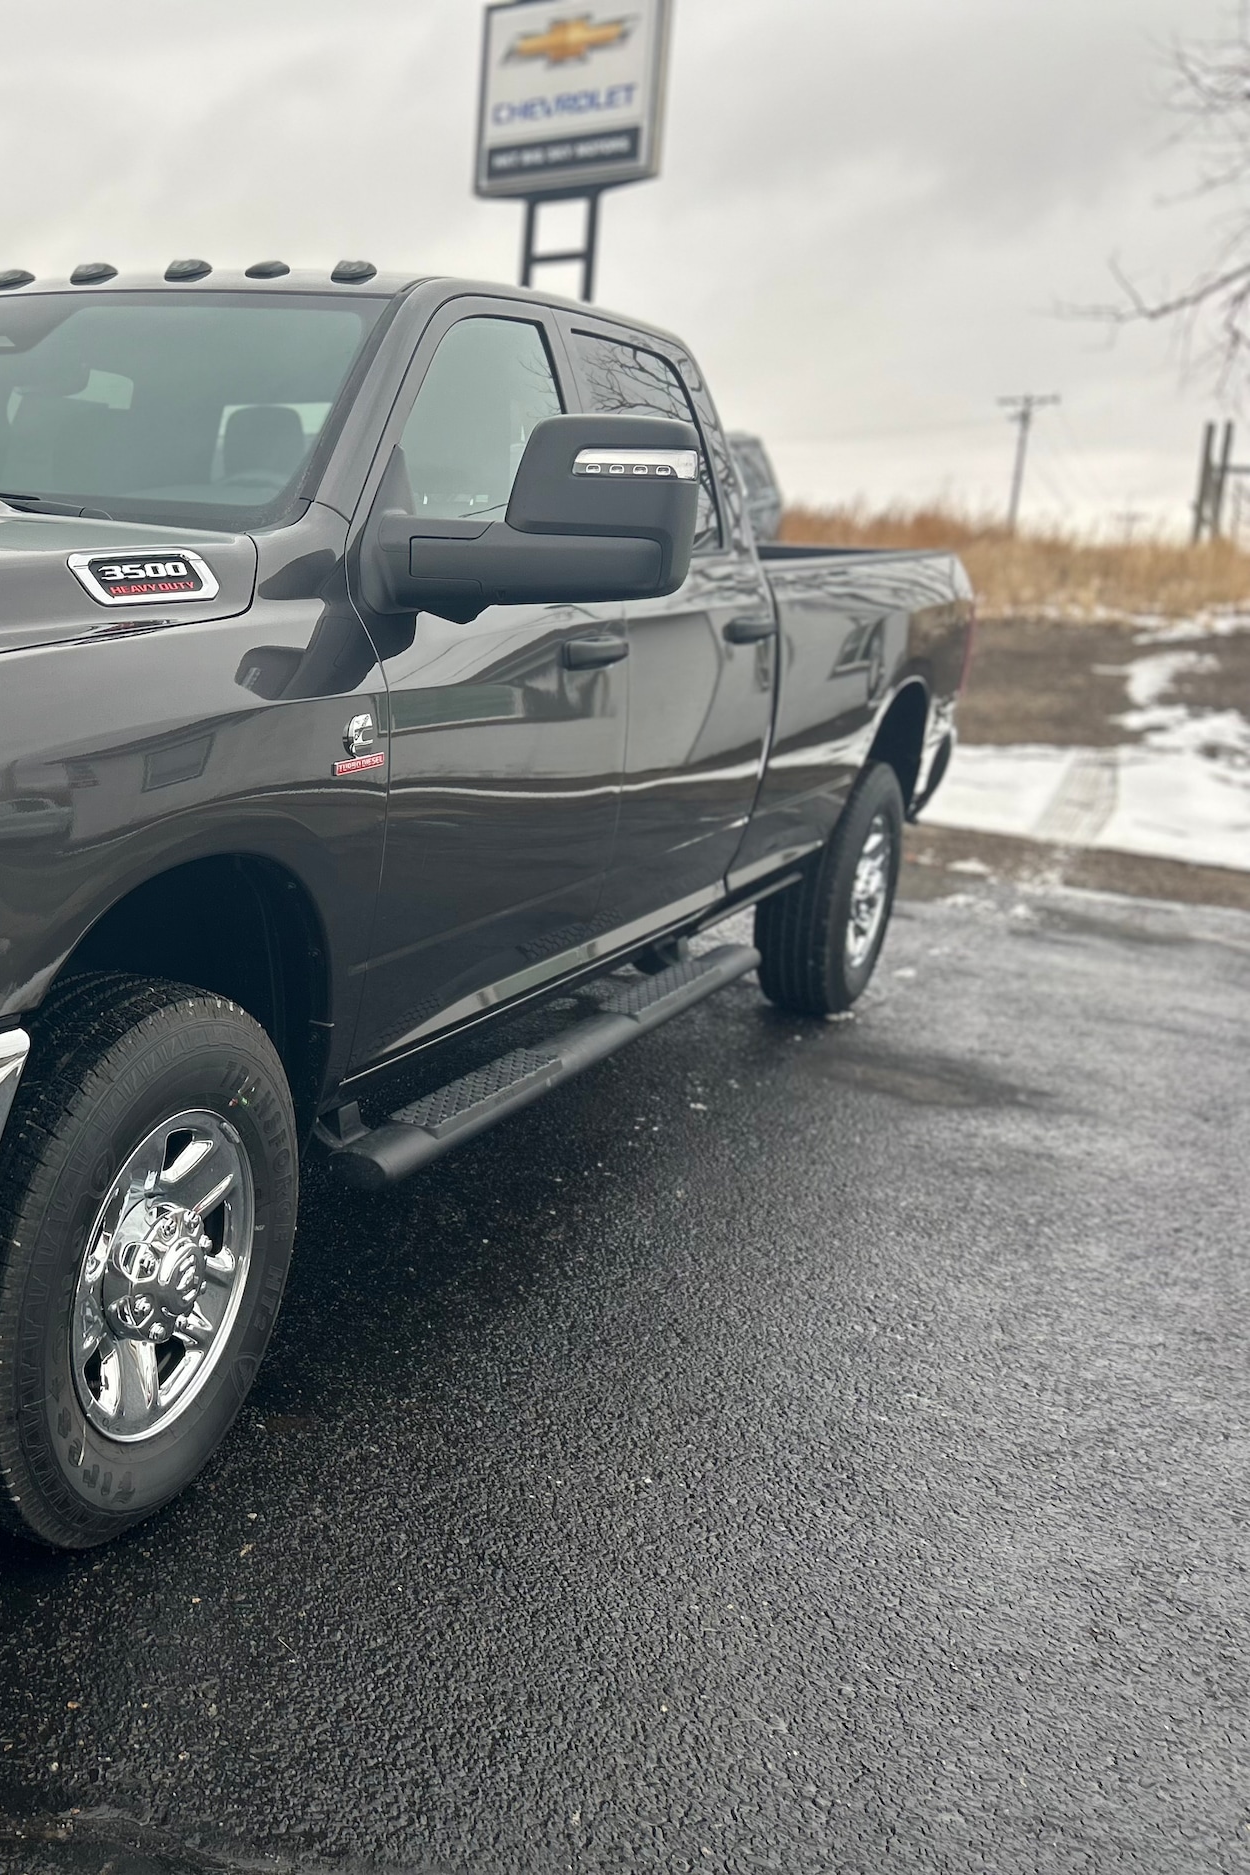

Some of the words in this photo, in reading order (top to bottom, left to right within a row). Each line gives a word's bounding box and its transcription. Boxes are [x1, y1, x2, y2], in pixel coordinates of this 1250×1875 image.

[492, 82, 636, 125] CHEVROLET
[98, 562, 188, 580] 3500
[110, 584, 157, 594] HEAVY
[158, 581, 195, 591] DUTY
